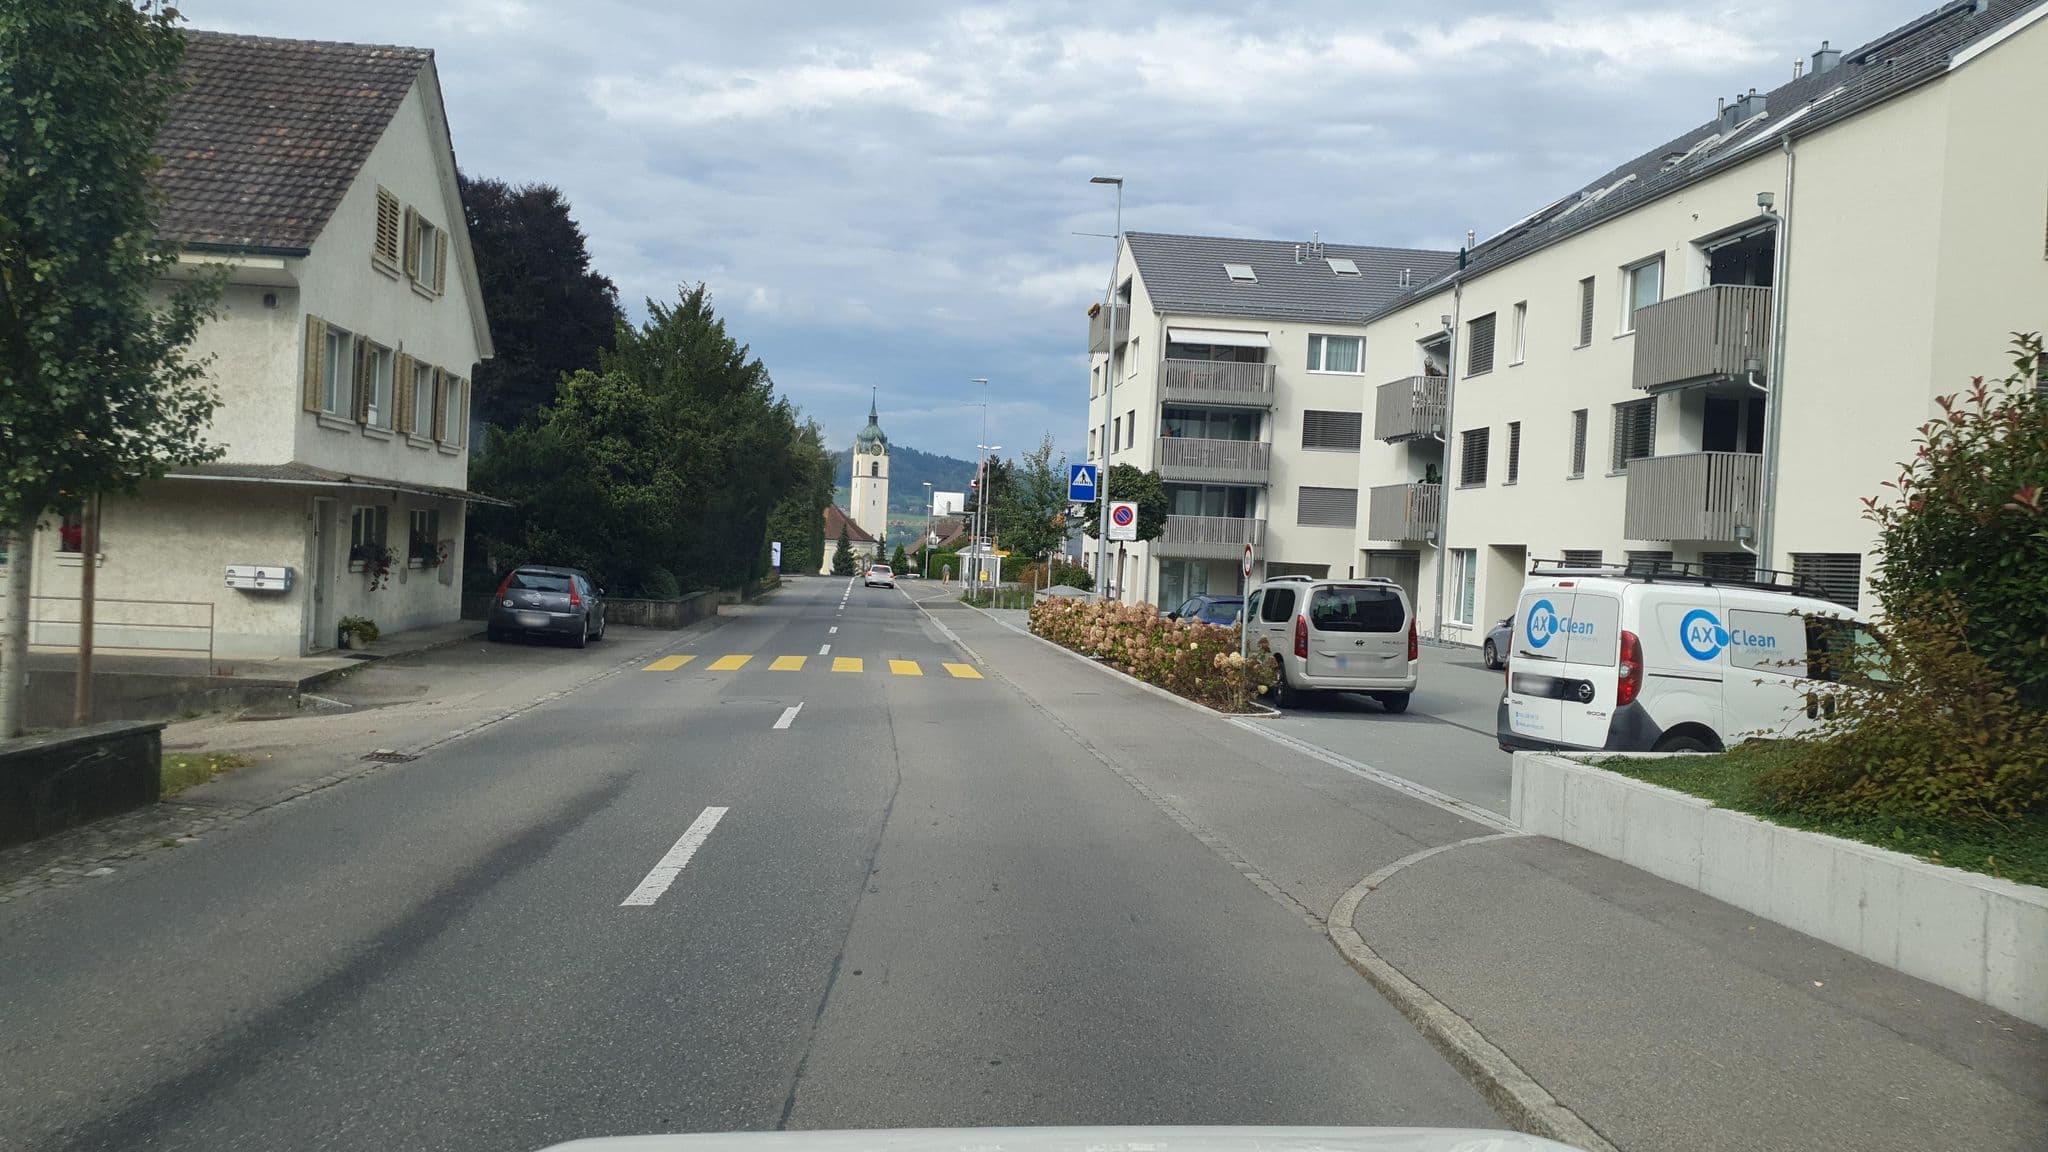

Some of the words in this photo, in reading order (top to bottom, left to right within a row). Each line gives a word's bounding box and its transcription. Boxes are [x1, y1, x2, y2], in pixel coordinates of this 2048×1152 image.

[1532, 616, 1549, 632] AX
[1559, 617, 1594, 635] Clean
[1690, 626, 1714, 643] AX
[1731, 629, 1776, 648] Clean
